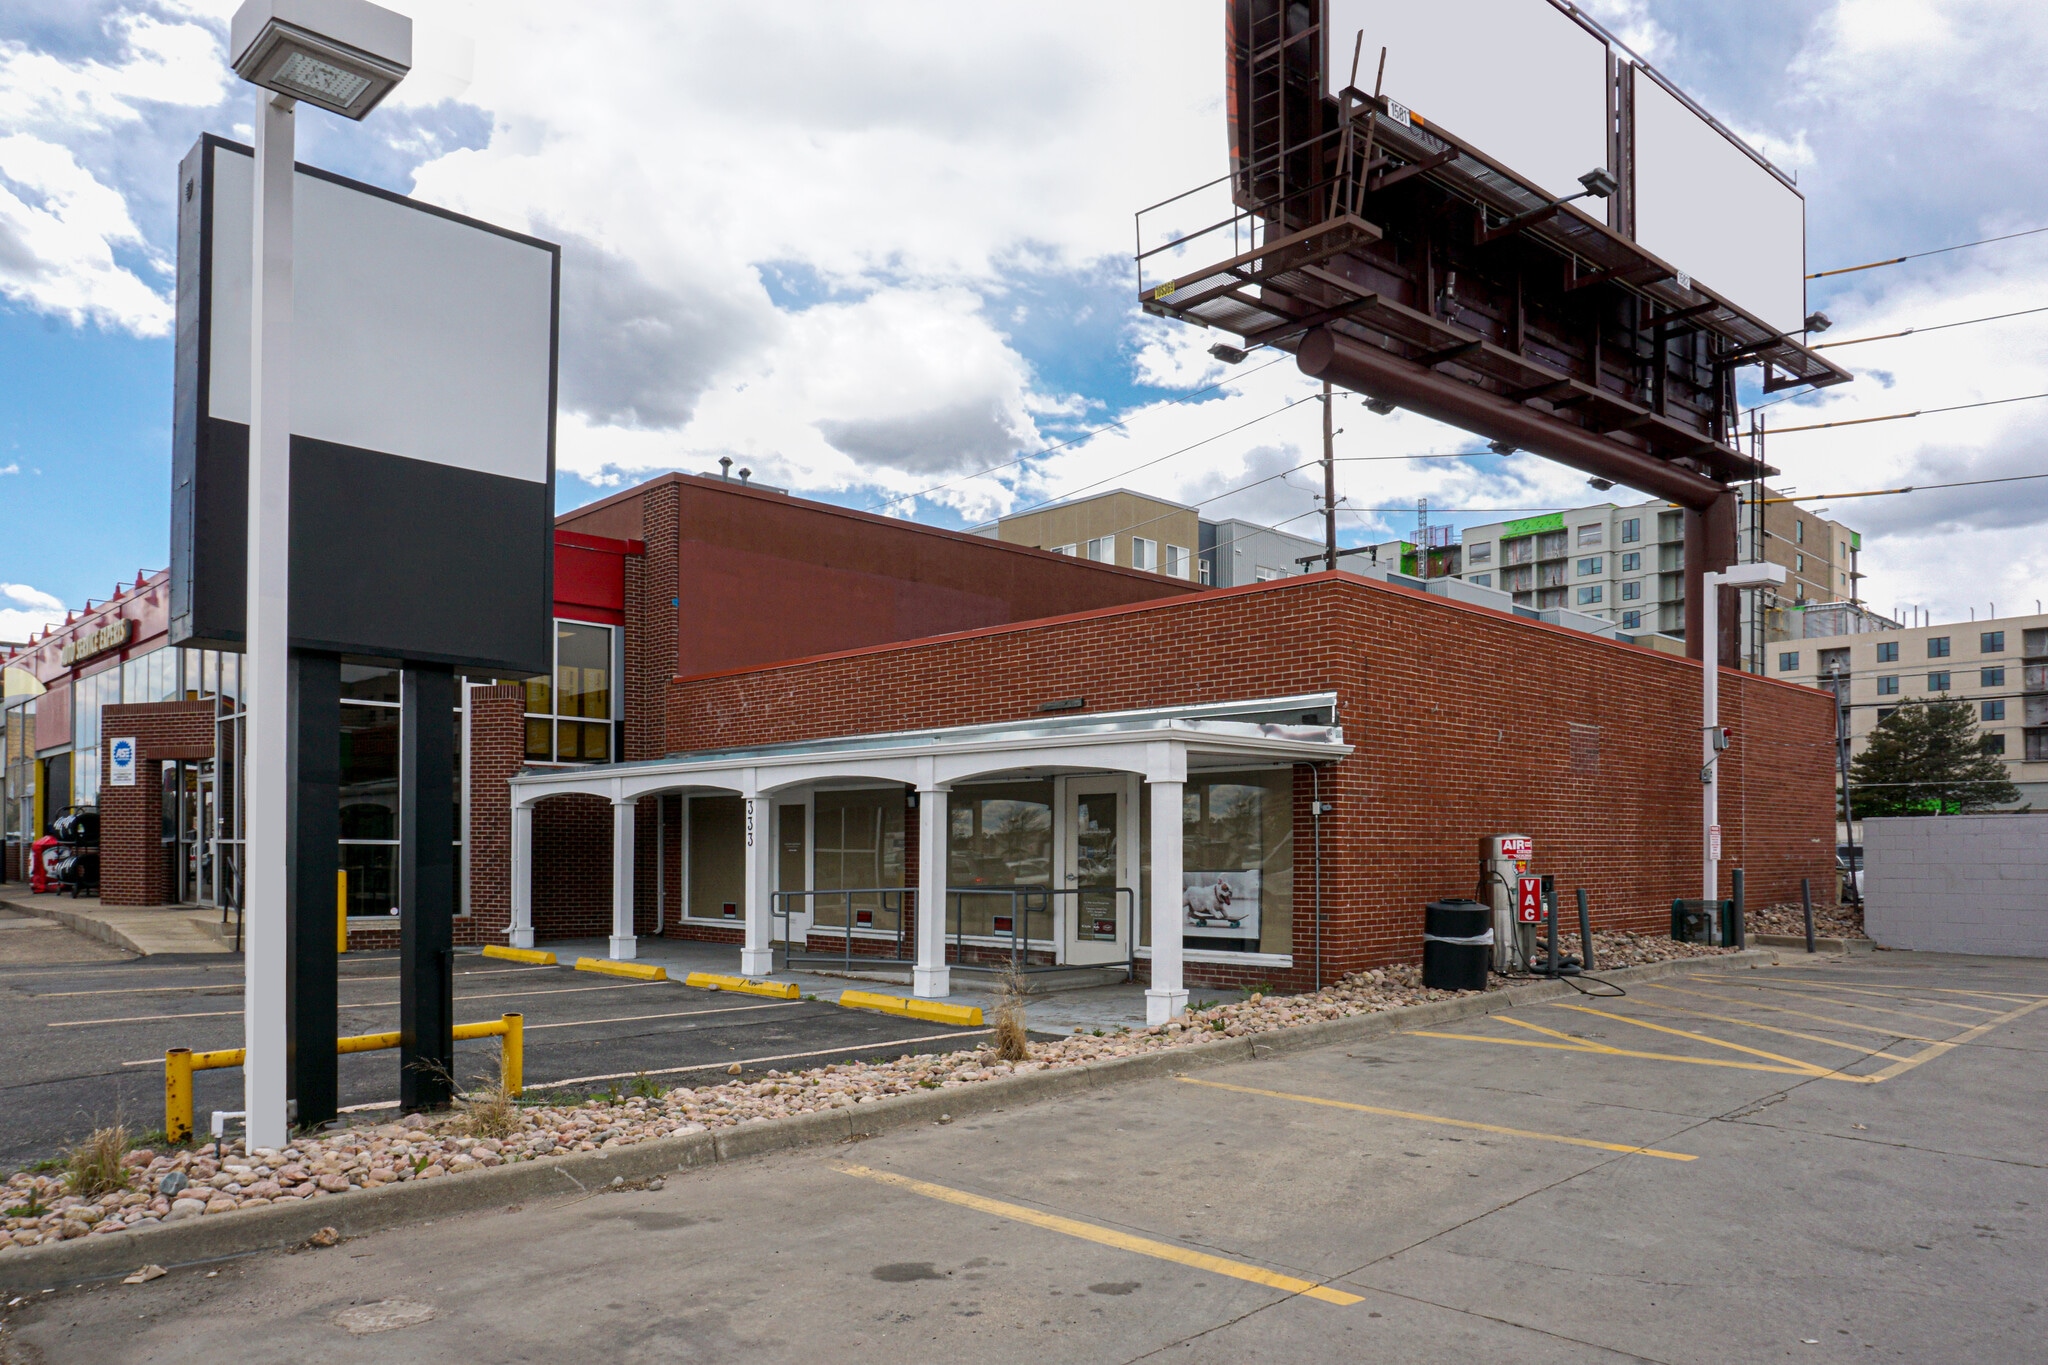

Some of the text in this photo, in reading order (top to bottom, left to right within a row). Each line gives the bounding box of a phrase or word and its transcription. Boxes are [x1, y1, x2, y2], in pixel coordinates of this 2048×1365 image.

[1391, 102, 1408, 124] 1581
[76, 630, 99, 660] SERVICE
[99, 618, 126, 651] EXPERTS
[116, 747, 130, 758] ASE
[1503, 839, 1524, 850] AIR
[1524, 880, 1535, 920] VAC
